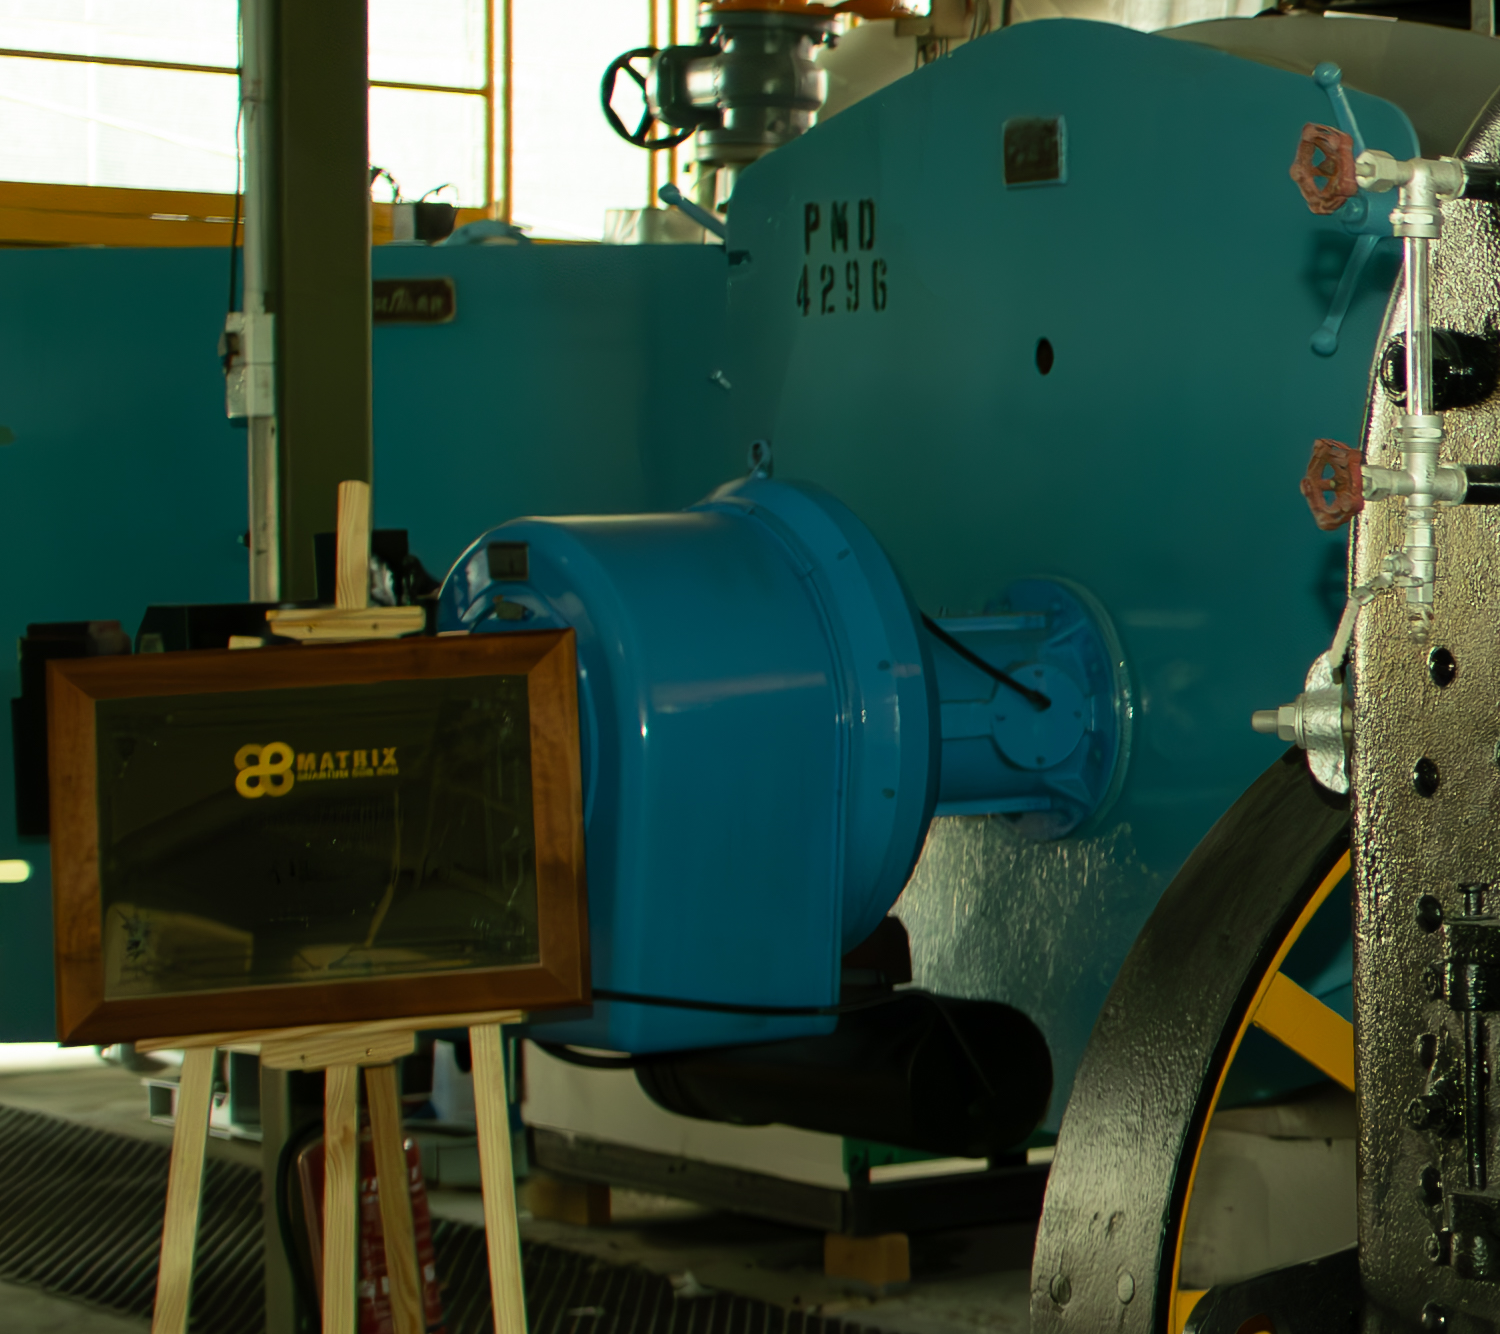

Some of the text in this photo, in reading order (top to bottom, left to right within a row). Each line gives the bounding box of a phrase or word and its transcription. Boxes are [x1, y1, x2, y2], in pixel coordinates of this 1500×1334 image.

[804, 197, 875, 255] PMD
[796, 258, 888, 317] 4296
[297, 747, 397, 771] MATRIX
